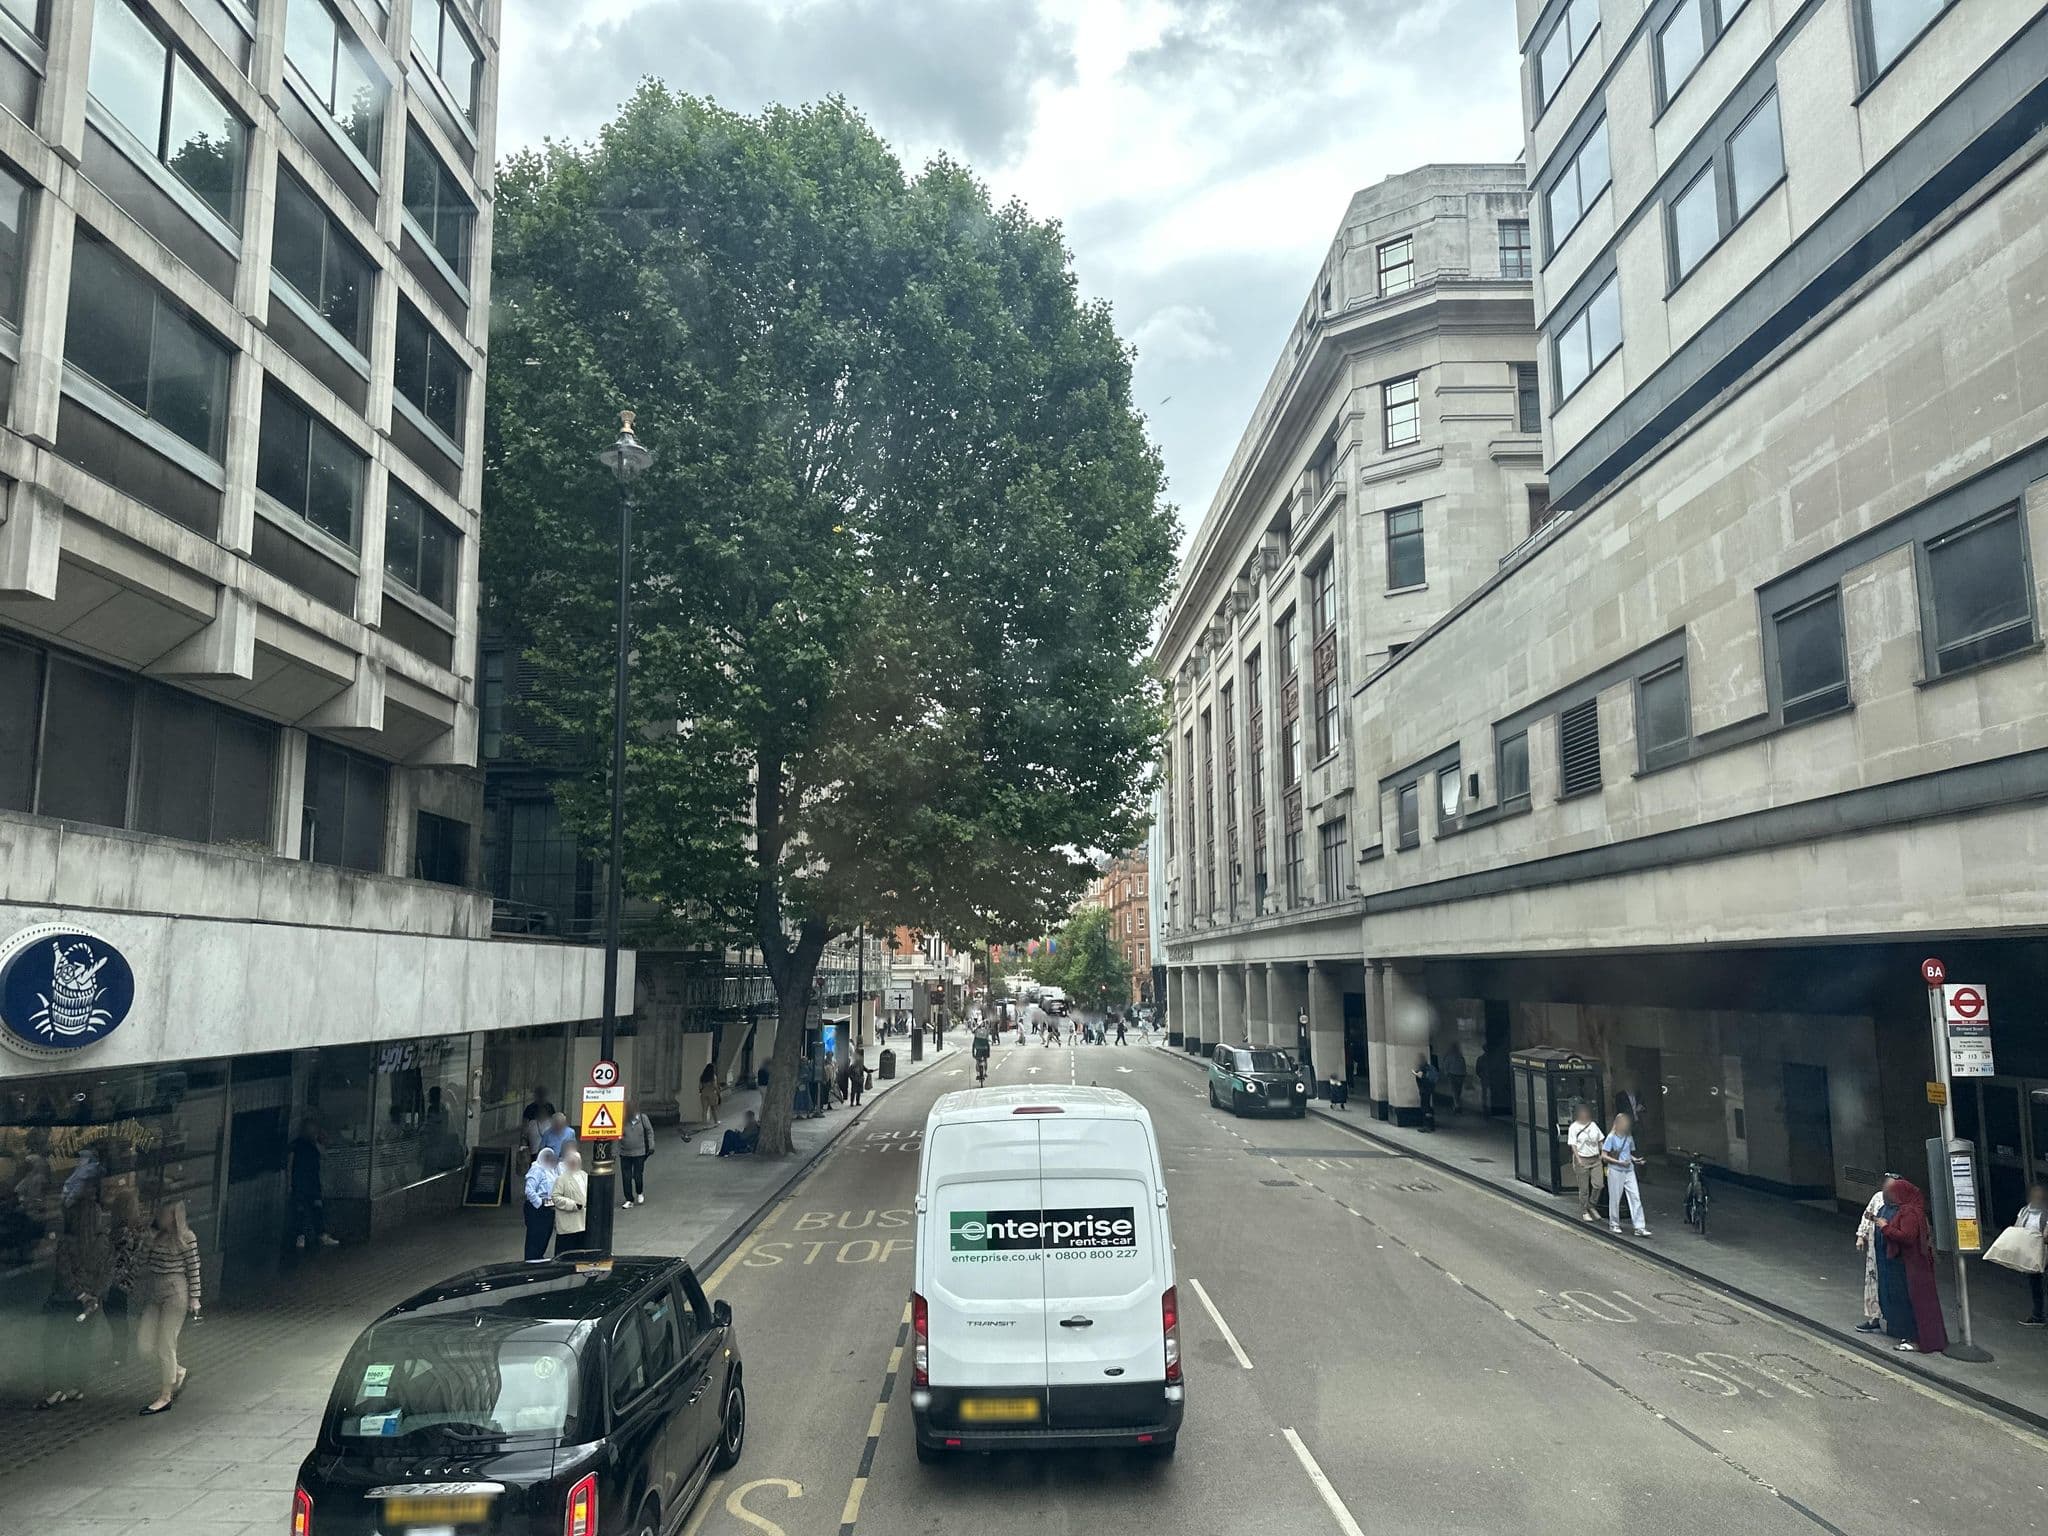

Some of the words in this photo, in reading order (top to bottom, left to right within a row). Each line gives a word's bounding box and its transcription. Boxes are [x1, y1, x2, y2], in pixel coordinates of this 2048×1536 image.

[1927, 966, 1943, 977] BA
[595, 1068, 613, 1080] 20
[792, 1209, 914, 1231] BUS
[961, 1214, 1133, 1244] enterprise
[1070, 1236, 1133, 1247] rent-a-car
[951, 1252, 1041, 1264] enterprise.co.uk
[1055, 1251, 1086, 1260] 0800
[1090, 1250, 1113, 1259] 800
[1116, 1249, 1138, 1258] 227
[405, 1467, 470, 1477] LEVC
